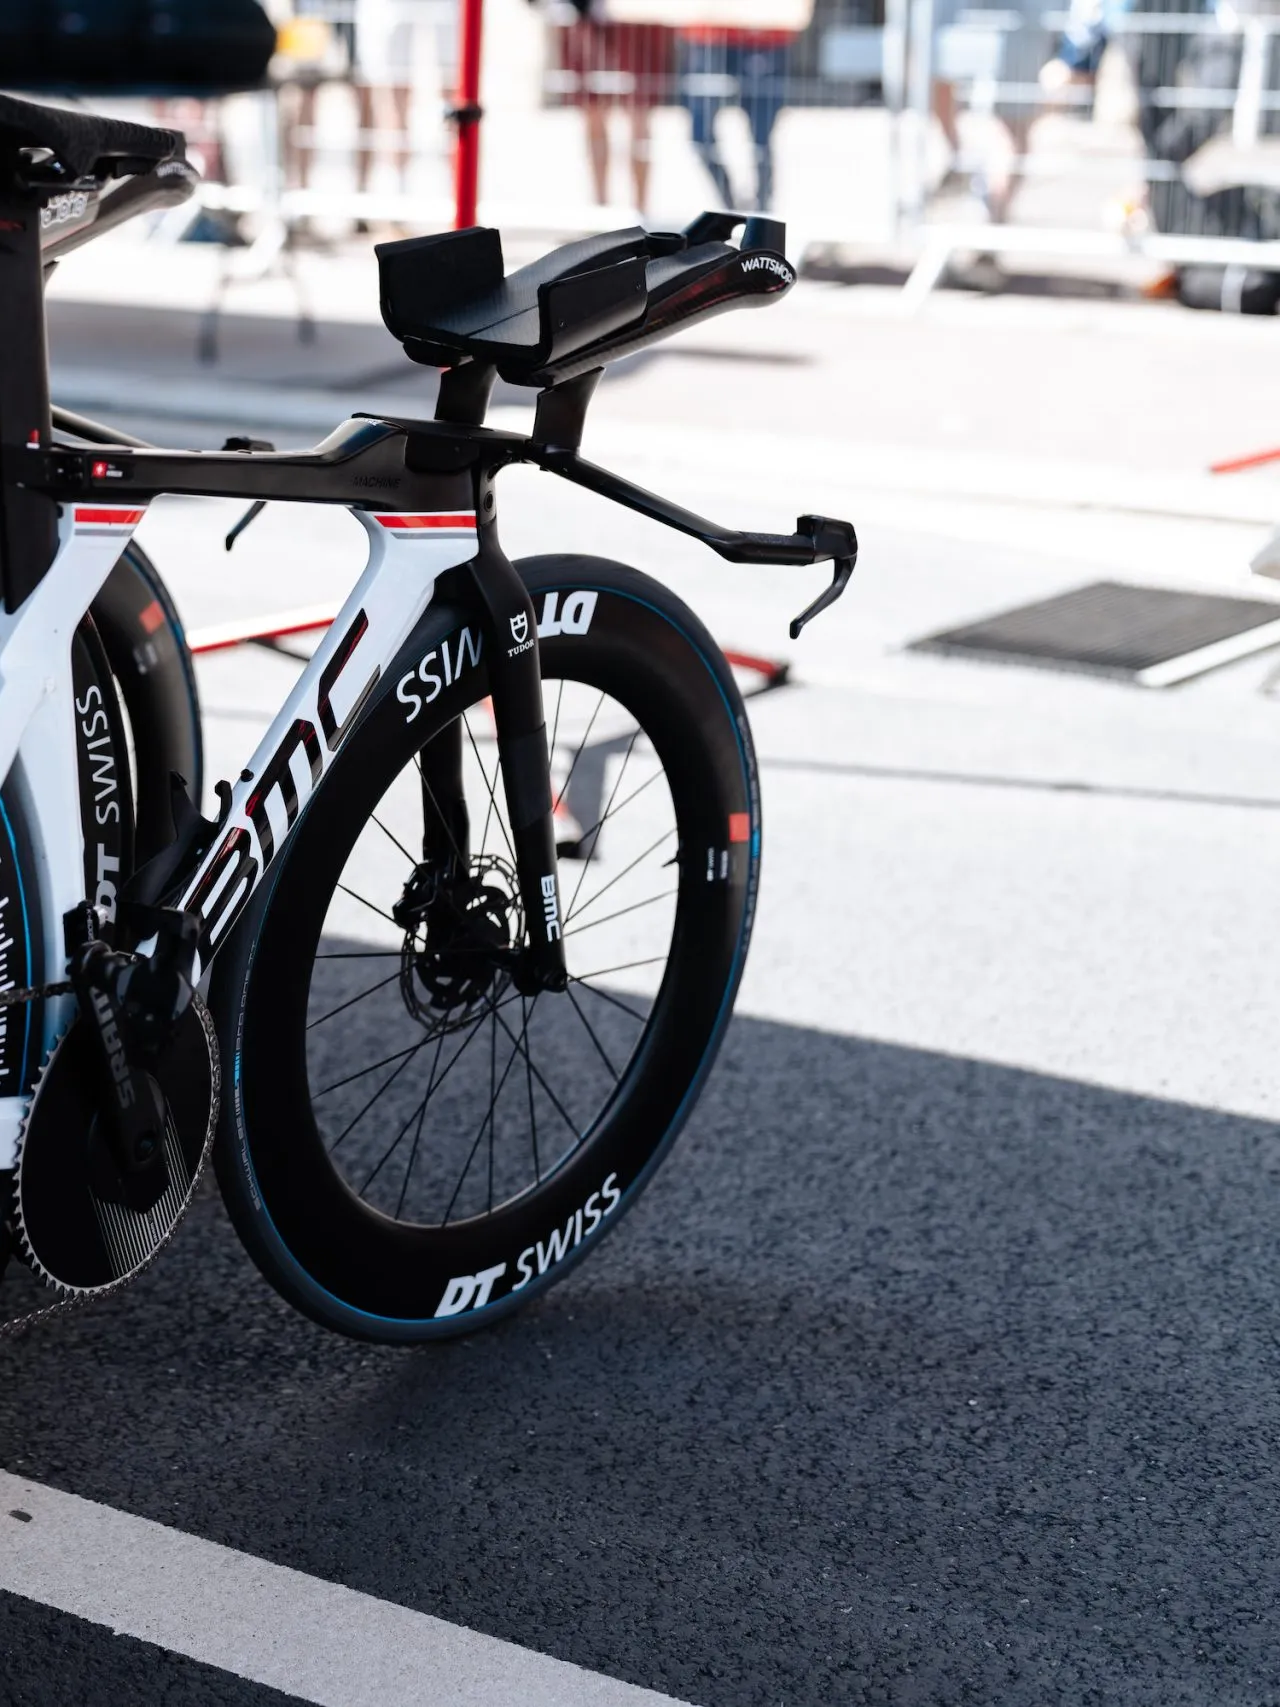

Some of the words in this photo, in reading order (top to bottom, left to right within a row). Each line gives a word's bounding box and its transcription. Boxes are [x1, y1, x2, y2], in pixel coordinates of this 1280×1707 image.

[741, 256, 793, 284] WATTSHOP
[507, 637, 536, 658] TUDOR
[536, 590, 599, 639] DT
[396, 625, 483, 724] WISS
[75, 684, 121, 825] SWISS
[184, 606, 382, 975] BMC
[95, 842, 121, 925] DT
[540, 873, 561, 943] BMC
[88, 985, 137, 1110] SRAM
[433, 1262, 507, 1319] DT
[512, 1172, 622, 1292] SWISS
